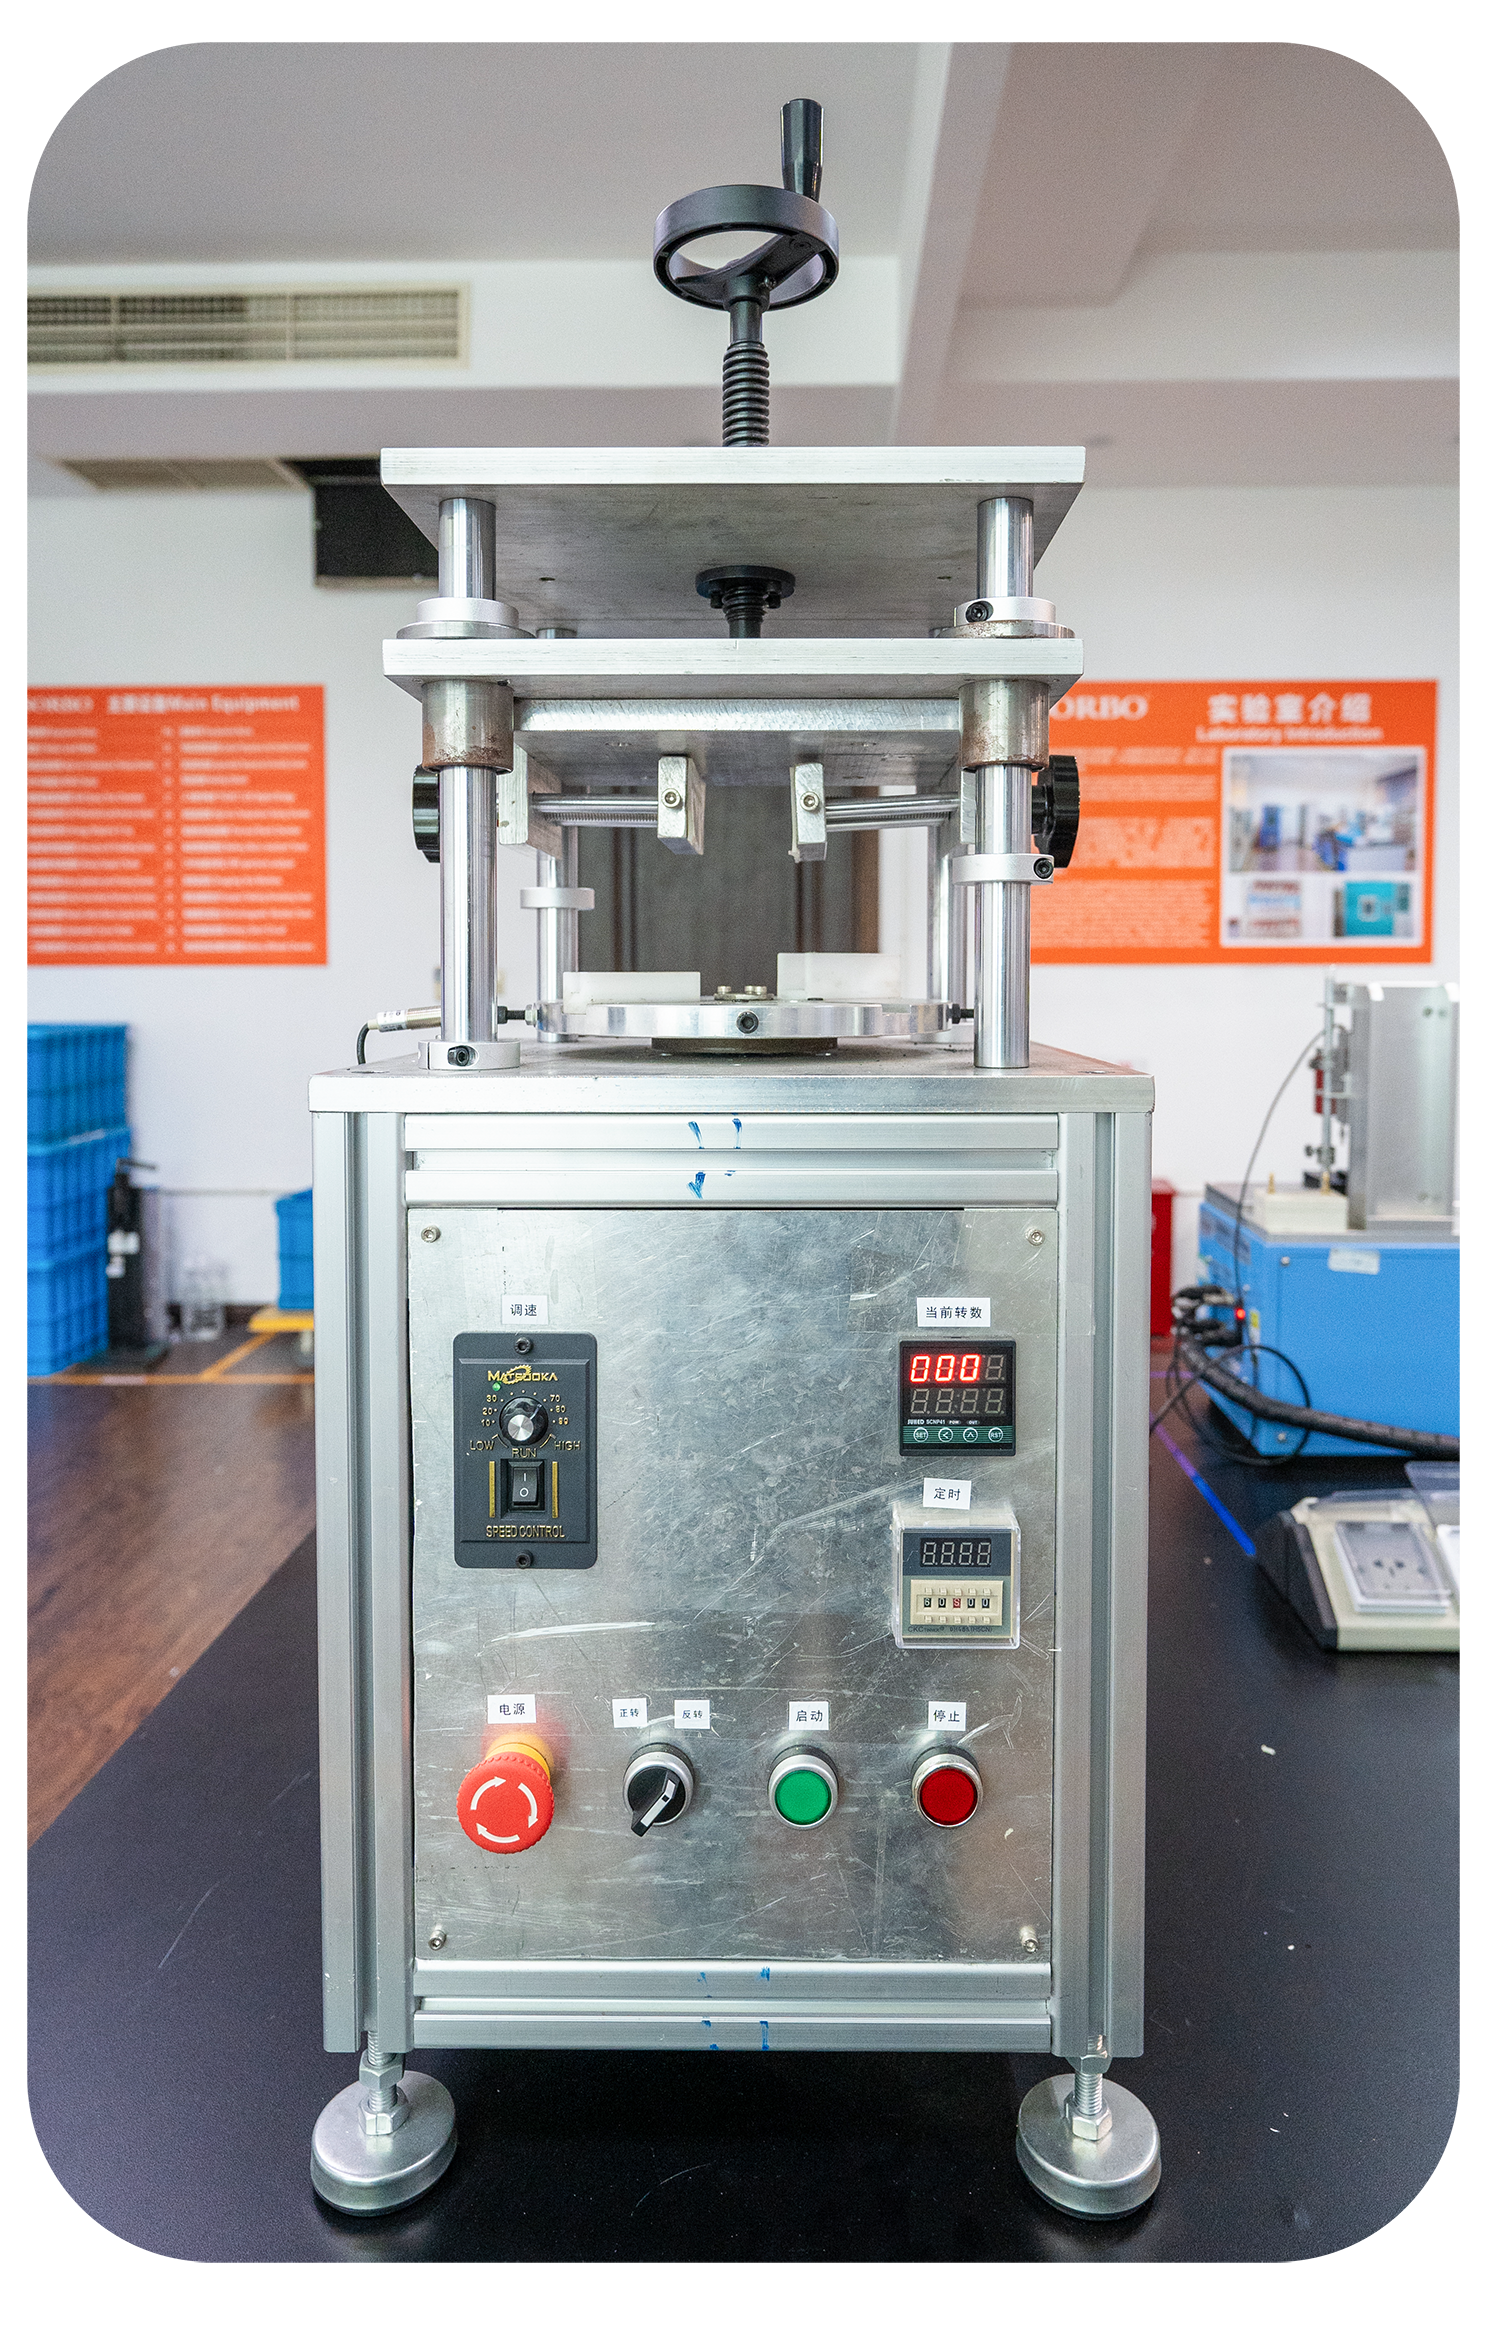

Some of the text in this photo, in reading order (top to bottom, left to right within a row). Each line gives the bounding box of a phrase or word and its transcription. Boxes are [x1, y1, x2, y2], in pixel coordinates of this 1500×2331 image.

[1207, 692, 1372, 724] 实验室介绍
[510, 1303, 538, 1316] 调速
[925, 1306, 982, 1319] 当前转数
[469, 1440, 495, 1451] LOW
[554, 1440, 581, 1451] HIGH
[511, 1447, 537, 1459] RUN
[933, 1487, 961, 1500] 定时
[485, 1525, 565, 1538] SPEED CONTROL
[499, 1703, 526, 1716] 电源
[619, 1708, 640, 1718] 正转
[682, 1709, 704, 1719] 反转
[795, 1710, 823, 1722] 启动
[933, 1709, 960, 1723] 停止
